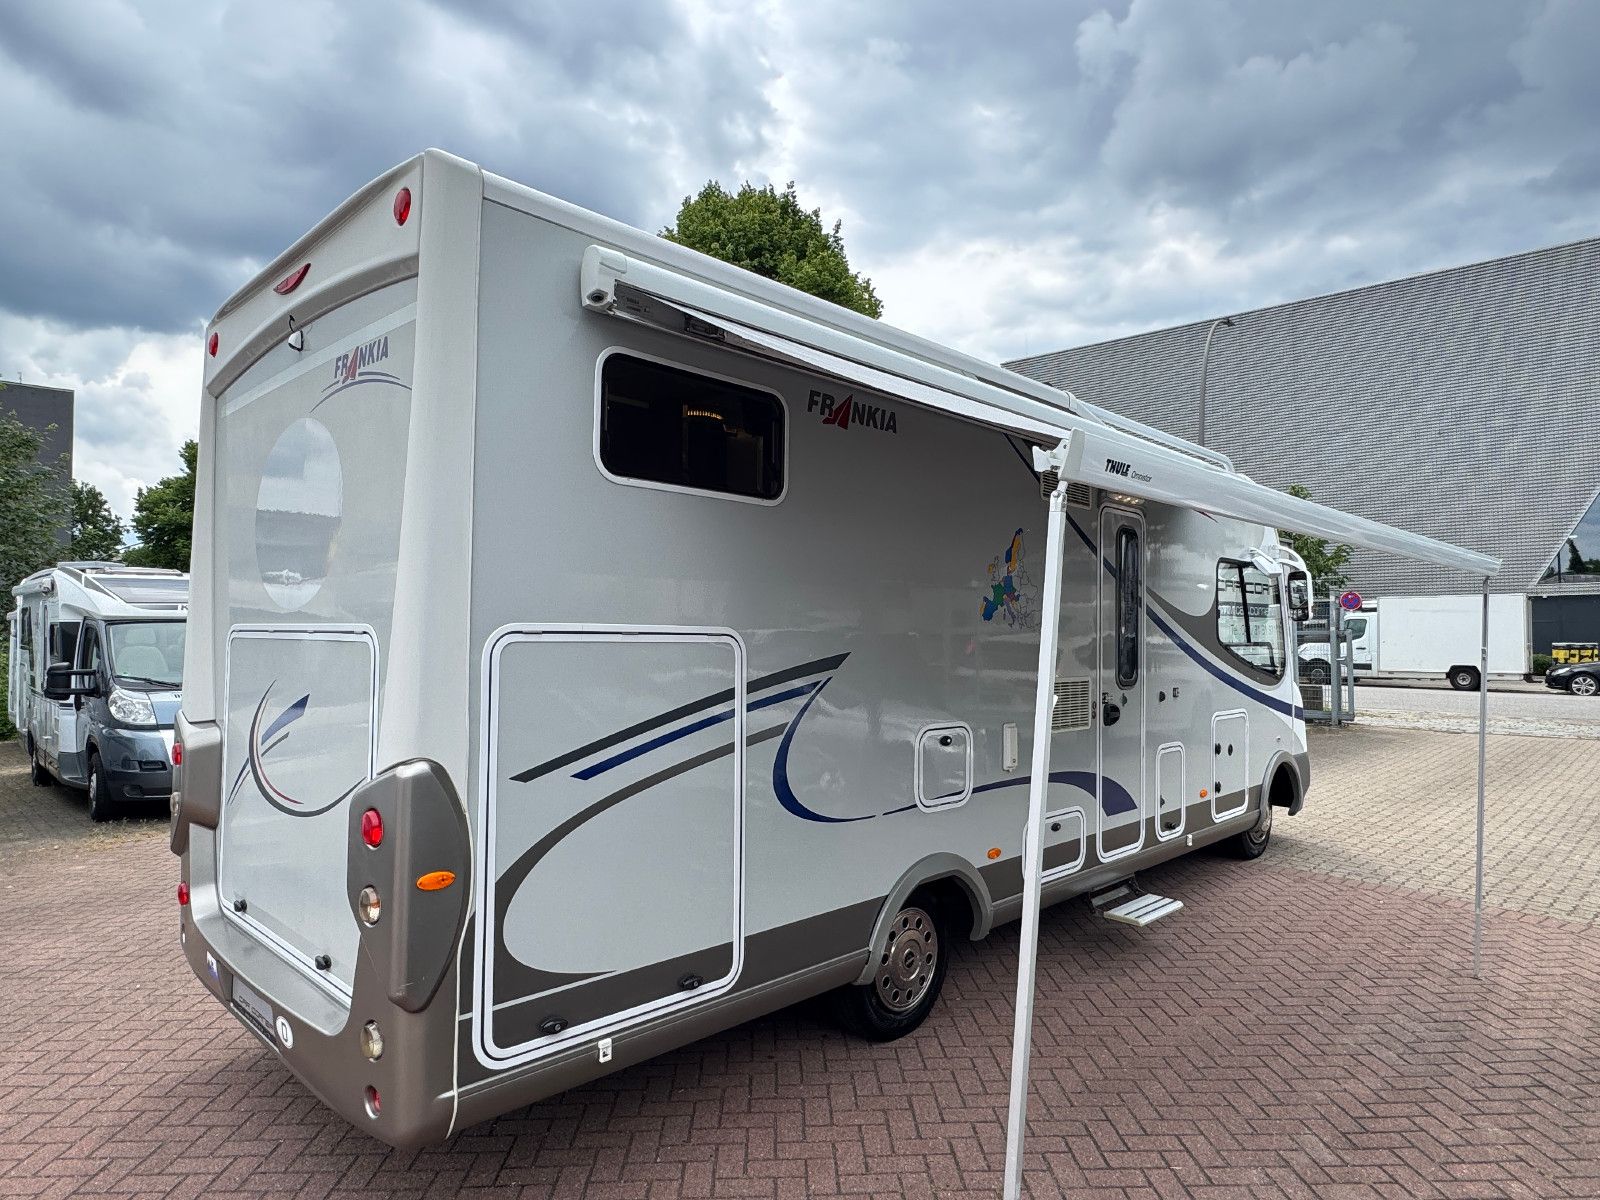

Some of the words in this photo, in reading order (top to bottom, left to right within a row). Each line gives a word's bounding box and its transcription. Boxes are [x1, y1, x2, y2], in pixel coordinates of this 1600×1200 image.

[334, 336, 388, 384] FRANKIA
[807, 389, 897, 434] FRANKIA
[1105, 458, 1131, 477] THULE
[281, 1021, 289, 1043] D
